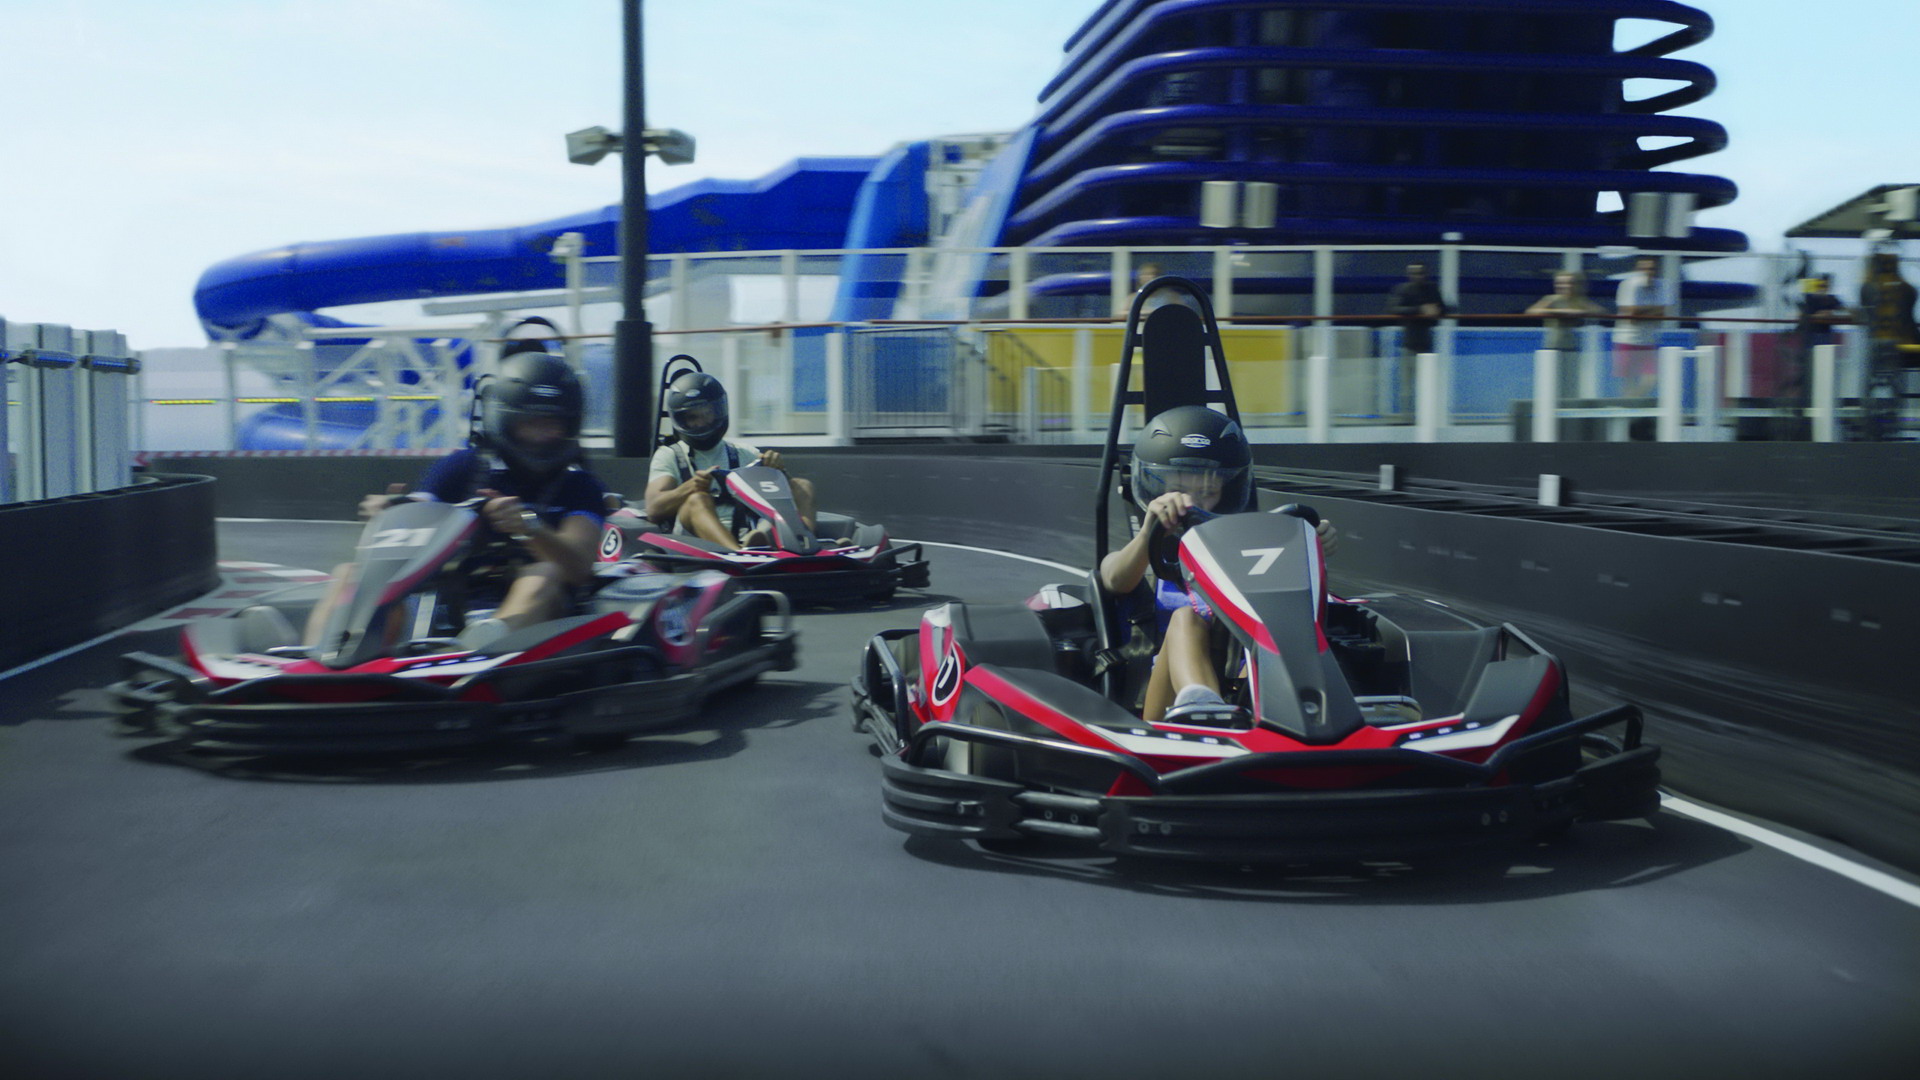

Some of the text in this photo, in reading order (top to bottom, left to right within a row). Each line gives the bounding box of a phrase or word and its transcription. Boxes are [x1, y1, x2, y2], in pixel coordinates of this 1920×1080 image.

[759, 481, 780, 493] 5
[362, 527, 437, 549] 21
[604, 533, 617, 551] 5
[1241, 547, 1285, 576] 7
